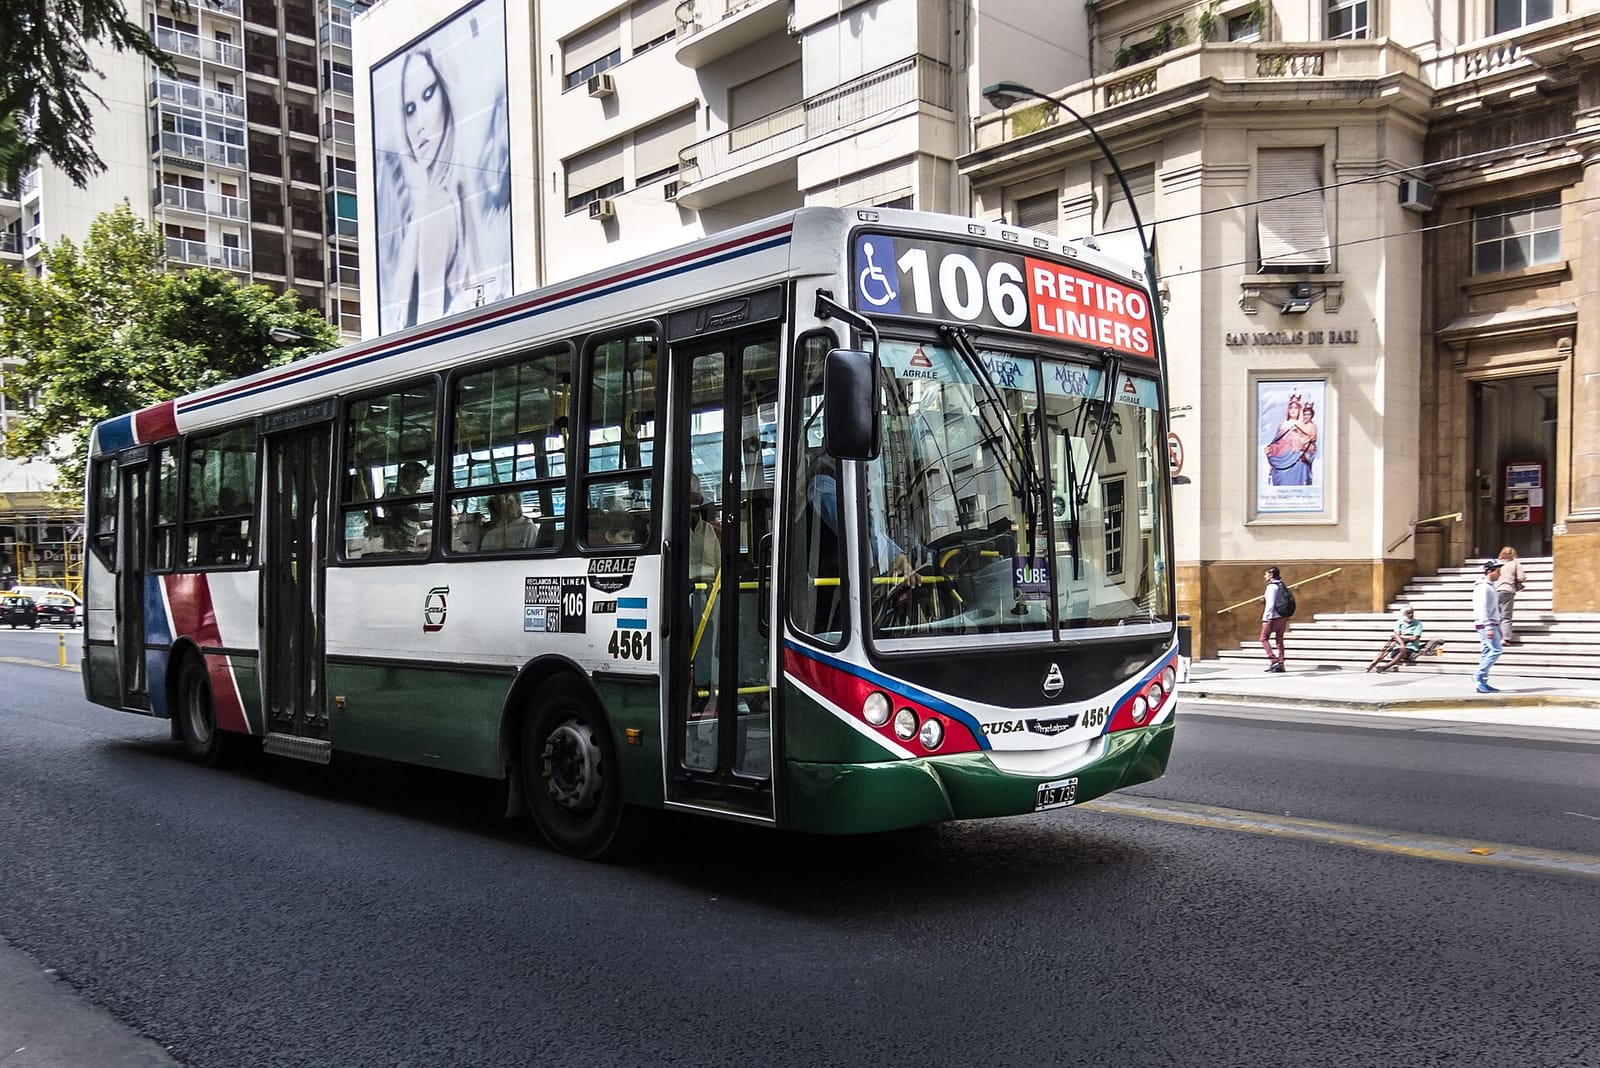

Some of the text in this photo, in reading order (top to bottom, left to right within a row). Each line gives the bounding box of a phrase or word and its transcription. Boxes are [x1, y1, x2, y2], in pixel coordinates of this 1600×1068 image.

[897, 248, 1027, 328] 106
[1033, 267, 1147, 321] RETIRO
[1037, 304, 1149, 353] LINIERS
[1225, 333, 1248, 346] SAN
[1308, 331, 1324, 344] DE
[902, 369, 938, 379] AGRALE
[982, 357, 1023, 376] MEGA
[1055, 366, 1088, 385] MEGA
[1061, 382, 1086, 396] CAR
[1120, 396, 1140, 405] AGRALE
[589, 559, 635, 573] AGRALE
[1016, 564, 1047, 583] SUBE
[562, 578, 585, 586] LINEA
[526, 608, 544, 616] CNRT
[563, 593, 583, 616] 106
[607, 630, 652, 661] 4561
[1081, 706, 1110, 729] 4561
[979, 720, 1024, 735] CUSA
[1037, 785, 1075, 806] LAS 739
